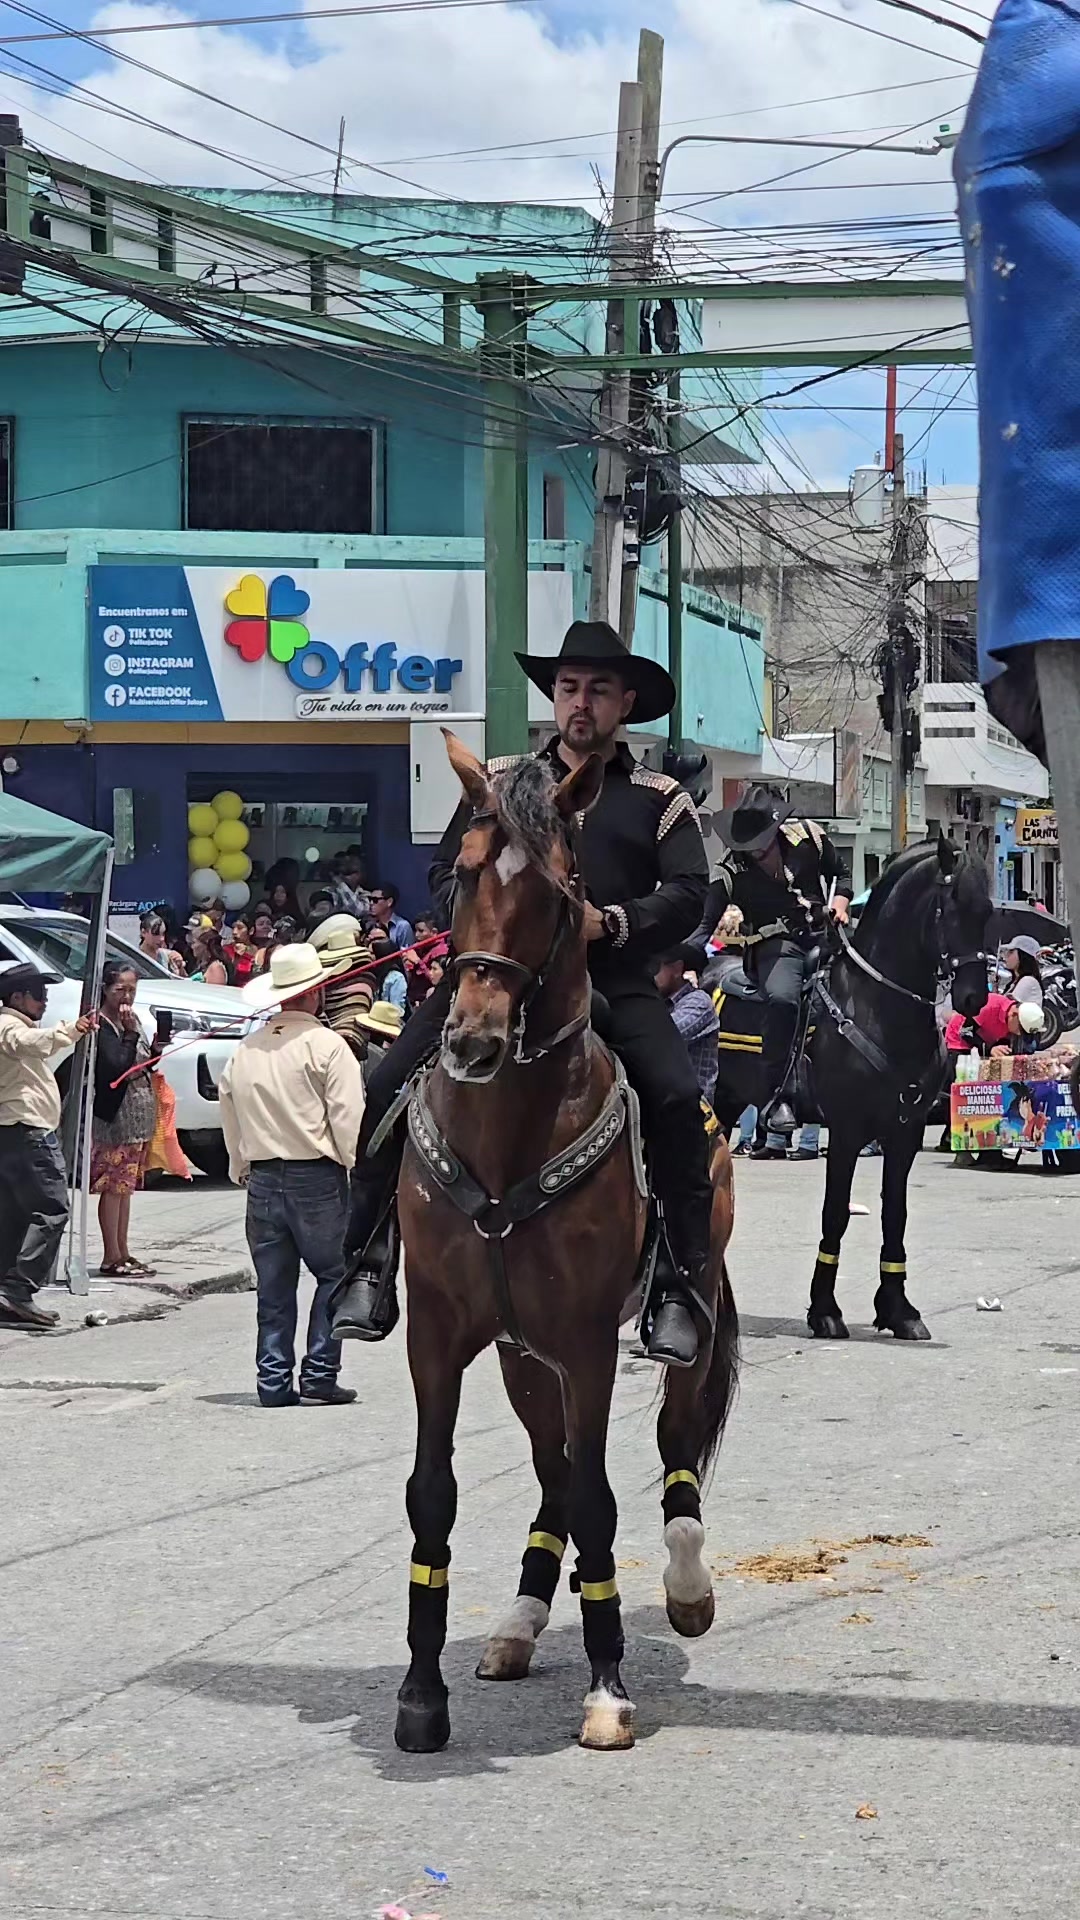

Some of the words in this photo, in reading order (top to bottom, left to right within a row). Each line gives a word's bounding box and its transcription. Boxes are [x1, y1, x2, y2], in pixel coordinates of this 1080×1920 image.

[98, 606, 170, 617] Encuentranos
[171, 607, 188, 616] en:
[128, 628, 147, 639] TIK
[148, 628, 173, 639] TOK
[127, 657, 194, 668] INSTAGRAM
[285, 640, 463, 693] Offer
[128, 686, 192, 697] FACEBOOK
[300, 697, 330, 716] Tu
[329, 699, 363, 712] vida
[364, 702, 384, 712] en
[385, 703, 408, 712] un
[409, 701, 449, 714] toque
[1024, 818, 1040, 827] LAS
[959, 1085, 1003, 1096] DELICIOSAS
[967, 1095, 996, 1105] MANIAS
[957, 1105, 1005, 1115] PREPARADAS
